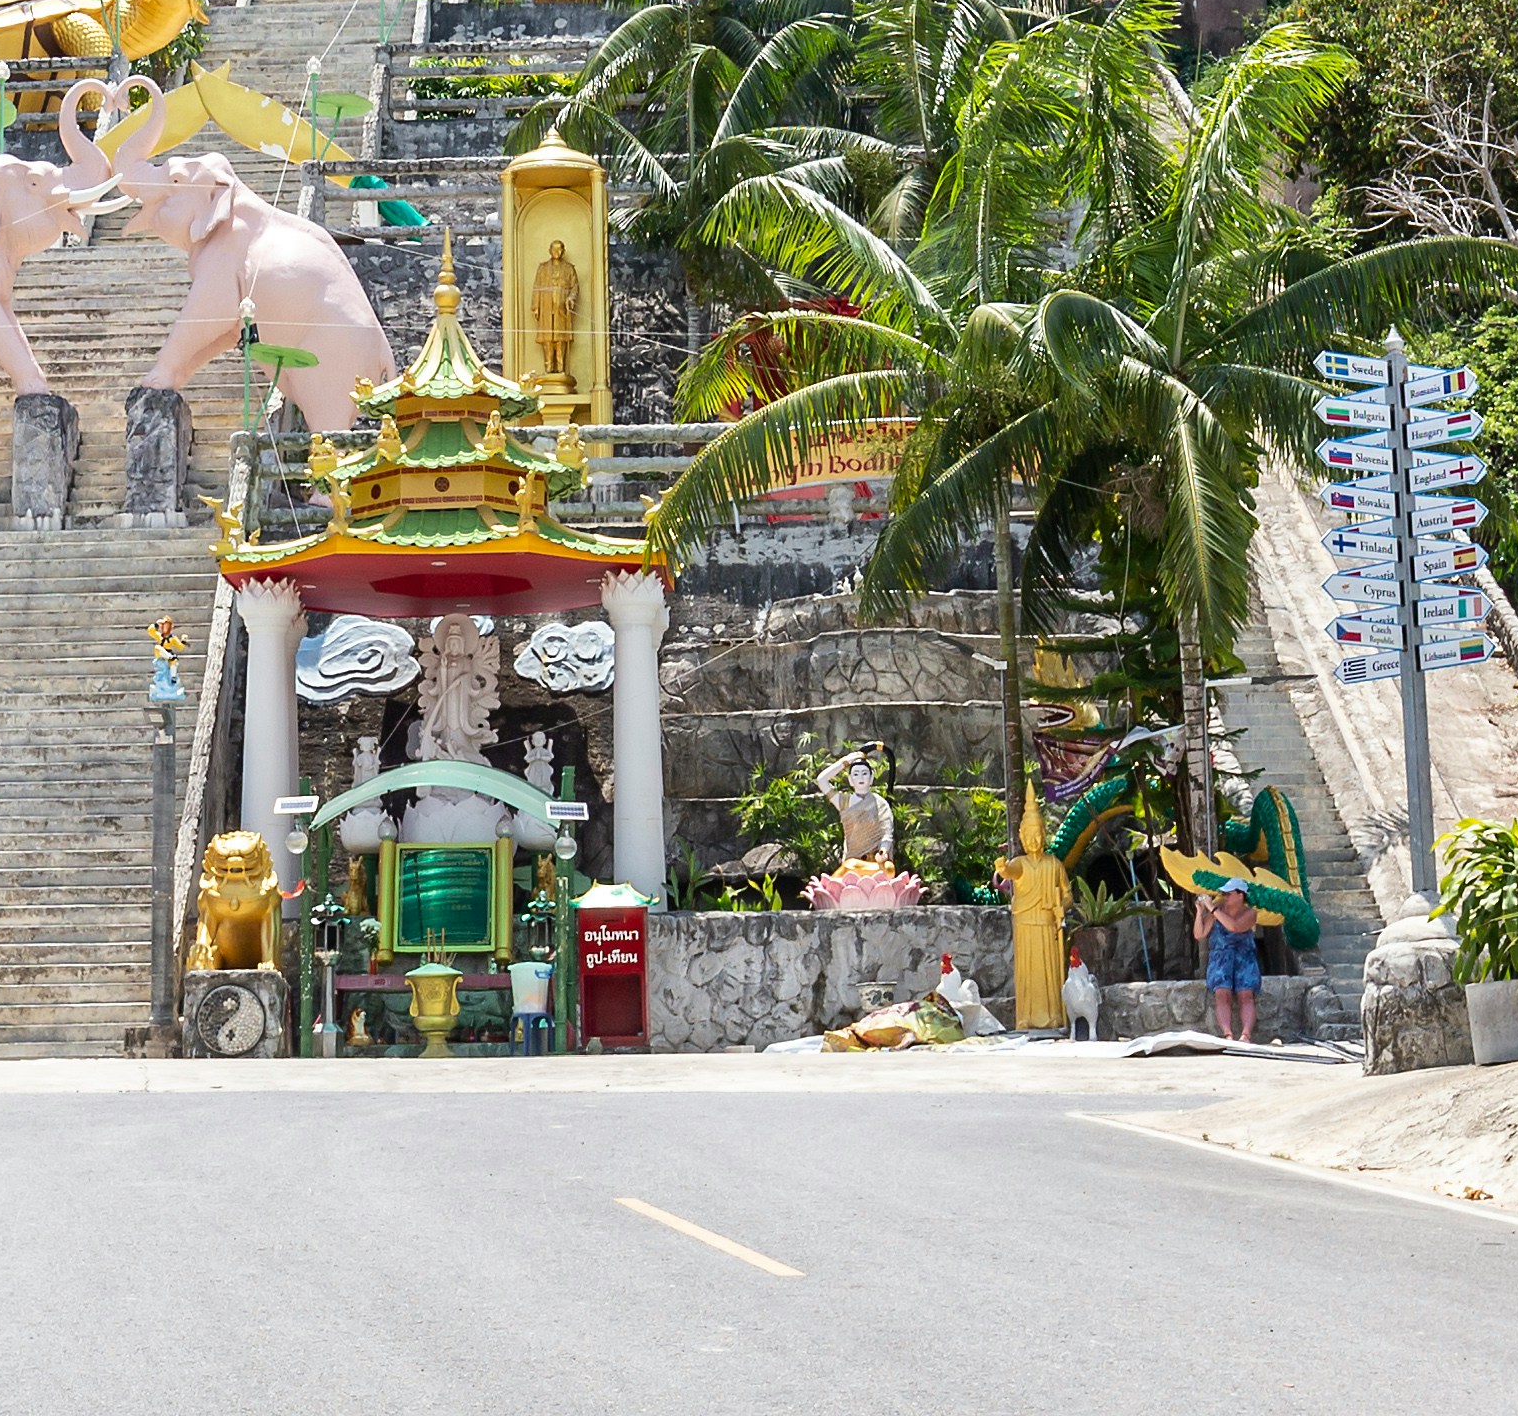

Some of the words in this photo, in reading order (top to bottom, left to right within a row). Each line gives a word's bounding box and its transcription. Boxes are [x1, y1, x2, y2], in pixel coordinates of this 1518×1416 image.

[1351, 363, 1384, 377] Sweden
[1410, 384, 1441, 399] Romania
[1353, 409, 1386, 423] Bulgaria
[1411, 427, 1444, 441] Hungary
[1355, 452, 1389, 466] Slovenia
[1414, 469, 1446, 486] England
[1357, 496, 1390, 509] Slovakia
[1417, 515, 1448, 529] Austria
[1360, 541, 1393, 554] Finland
[1423, 559, 1447, 574] Spain
[1363, 584, 1396, 599] Cyprus
[1423, 603, 1454, 619] Ireland
[1371, 624, 1392, 634] Czech
[1369, 634, 1394, 645] Republic
[1424, 649, 1457, 663] Lithuania
[1372, 660, 1400, 672] Greece
[584, 924, 639, 946] อนุโมทนา
[586, 949, 638, 969] ธูป-เทียน
